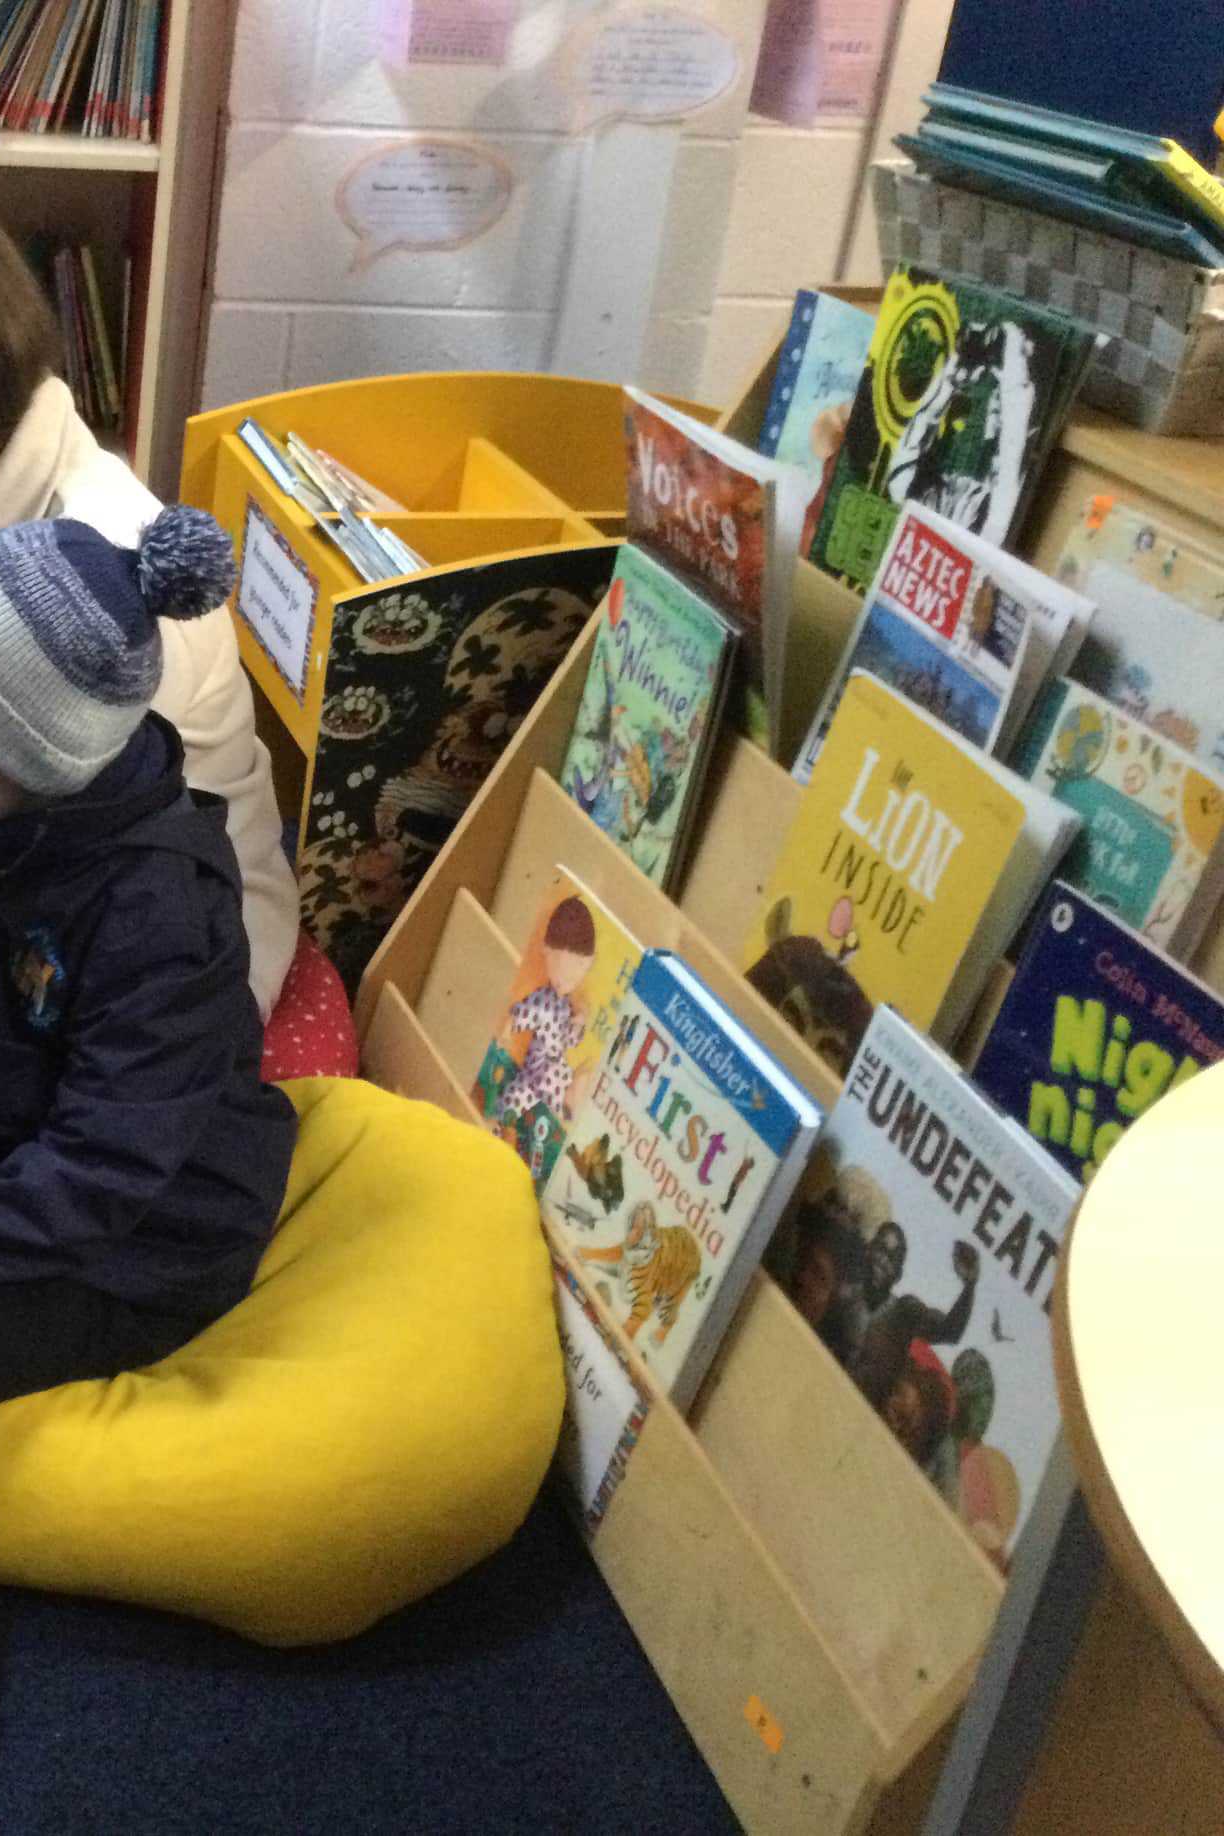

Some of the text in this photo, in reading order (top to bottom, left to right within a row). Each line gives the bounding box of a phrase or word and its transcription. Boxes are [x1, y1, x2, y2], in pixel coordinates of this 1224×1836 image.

[883, 559, 953, 629] NEWS
[896, 528, 966, 601] AZTEC
[820, 829, 926, 956] INSIDE
[662, 992, 754, 1095] Kingfisher
[847, 1045, 883, 1104] THE
[623, 1021, 728, 1187] First
[590, 1070, 726, 1260] Encyclopedia
[866, 1064, 1060, 1313] UNDEFEAT
[577, 1366, 603, 1402] for
